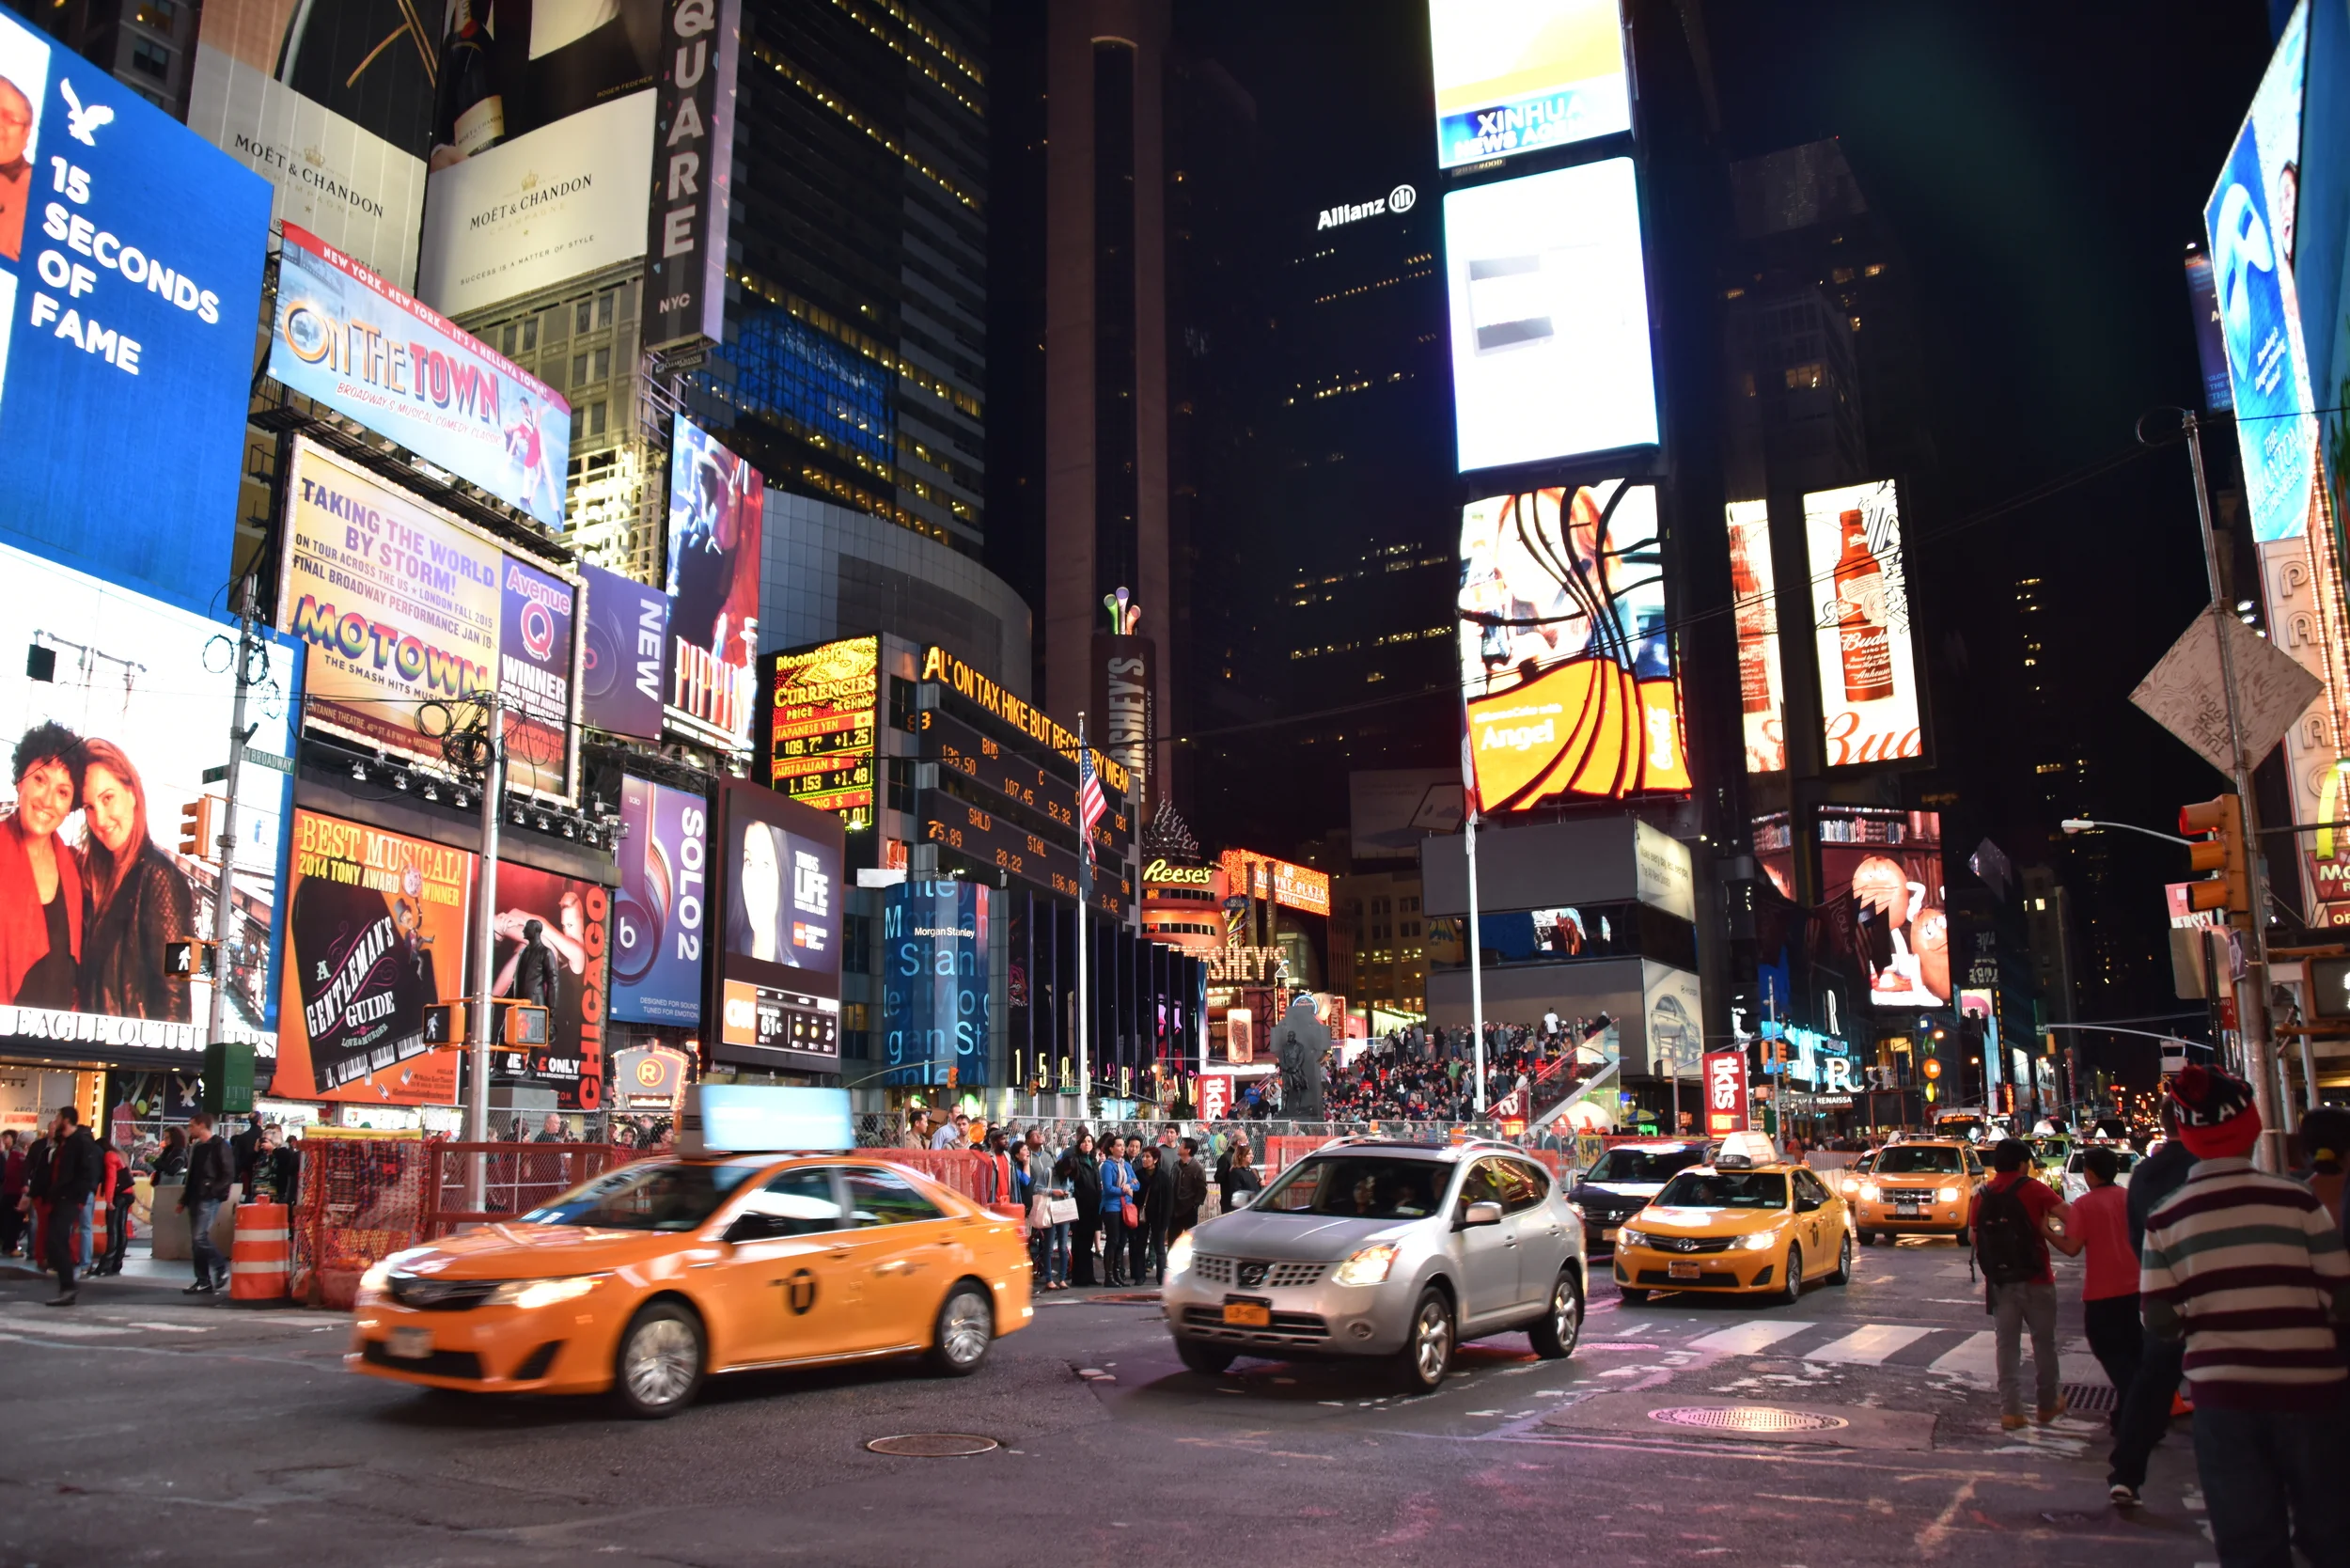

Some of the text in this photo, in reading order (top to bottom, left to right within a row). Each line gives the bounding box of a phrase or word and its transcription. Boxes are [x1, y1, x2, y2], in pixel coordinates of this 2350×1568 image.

[1478, 95, 1587, 137] XINHUA
[1454, 131, 1518, 160] NEWS
[51, 156, 90, 205] 15
[235, 133, 384, 218] MOËT & CHANDON
[470, 173, 592, 230] MOËT & CHANDON
[1317, 197, 1386, 230] Allianz
[38, 249, 97, 298] OF
[43, 202, 220, 324] SECONDS
[460, 268, 496, 286] SUCCESS
[518, 249, 550, 264] MATTER
[555, 244, 564, 253] OF
[568, 235, 594, 248] STYLE
[323, 246, 348, 270] NEW
[352, 261, 384, 292] YORK,
[388, 287, 410, 307] NEW
[452, 326, 470, 347] IT'S
[471, 341, 478, 353] A
[479, 346, 518, 381] HELLUVA
[659, 292, 691, 313] NYC
[31, 291, 142, 375] FAME
[283, 301, 502, 427] ON THE TOWN
[337, 381, 503, 447] BROADWAY'S MUSICAL COMEDY CLASSIC
[302, 477, 495, 588] TAKING THE WORLD
[345, 525, 457, 597] BY STORM!
[295, 533, 494, 629] ON TOUR ACROSS THE US LONDON FALL 2015
[507, 565, 571, 616] Avenue
[293, 555, 492, 649] FINAL BROADWAY PERFORMANCE JAN 18
[521, 600, 555, 662] Q
[292, 593, 488, 705] MOTOWN
[636, 598, 663, 702] NEW
[776, 647, 845, 671] Bloomberg
[324, 654, 411, 695] THE SMASH HITS
[502, 653, 566, 698] WINNER
[775, 674, 877, 708] CURRENCIES
[522, 687, 541, 703] TONY
[541, 696, 566, 715] AWARD
[787, 707, 813, 721] PRICE
[954, 660, 1051, 745] ON TAX HIKE BUT
[776, 719, 838, 740] JAPANESE YEN
[835, 729, 869, 747] +1.25
[1480, 718, 1554, 751] Angel
[251, 749, 292, 772] BROADWAY
[775, 756, 840, 778] AUSTRALIAN $
[790, 767, 868, 794] 1.153 +1.48
[1004, 777, 1034, 806] 107.45
[1039, 770, 1044, 786] C
[835, 795, 843, 808] $
[1048, 801, 1072, 826] 52.32
[968, 808, 991, 831] SHLD
[301, 816, 462, 886] BEST MUSICAL!
[996, 848, 1022, 873] 28.22
[1026, 836, 1046, 857] SIAL
[298, 854, 460, 907] 2014 TONY AWARD WINNER
[678, 806, 705, 961] SOLO 2
[1052, 872, 1078, 896] 136.08
[1143, 858, 1213, 885] Reese's
[1102, 894, 1118, 913] 3.42
[1297, 882, 1325, 901] PLAZA
[915, 927, 975, 939] Morgan Stanley
[306, 916, 394, 1038] GENTLEMAN'S
[317, 960, 331, 981] A
[345, 991, 396, 1028] GUIDE
[578, 886, 608, 1109] CHICAGO
[640, 996, 667, 1006] DESIGNED
[668, 999, 680, 1008] FOR
[643, 1006, 661, 1014] TUNED
[13, 1009, 110, 1043] EAGLE
[548, 1058, 580, 1074] ONLY
[641, 1064, 657, 1081] R
[1825, 1058, 1865, 1093] R
[1713, 1057, 1739, 1110] tkts
